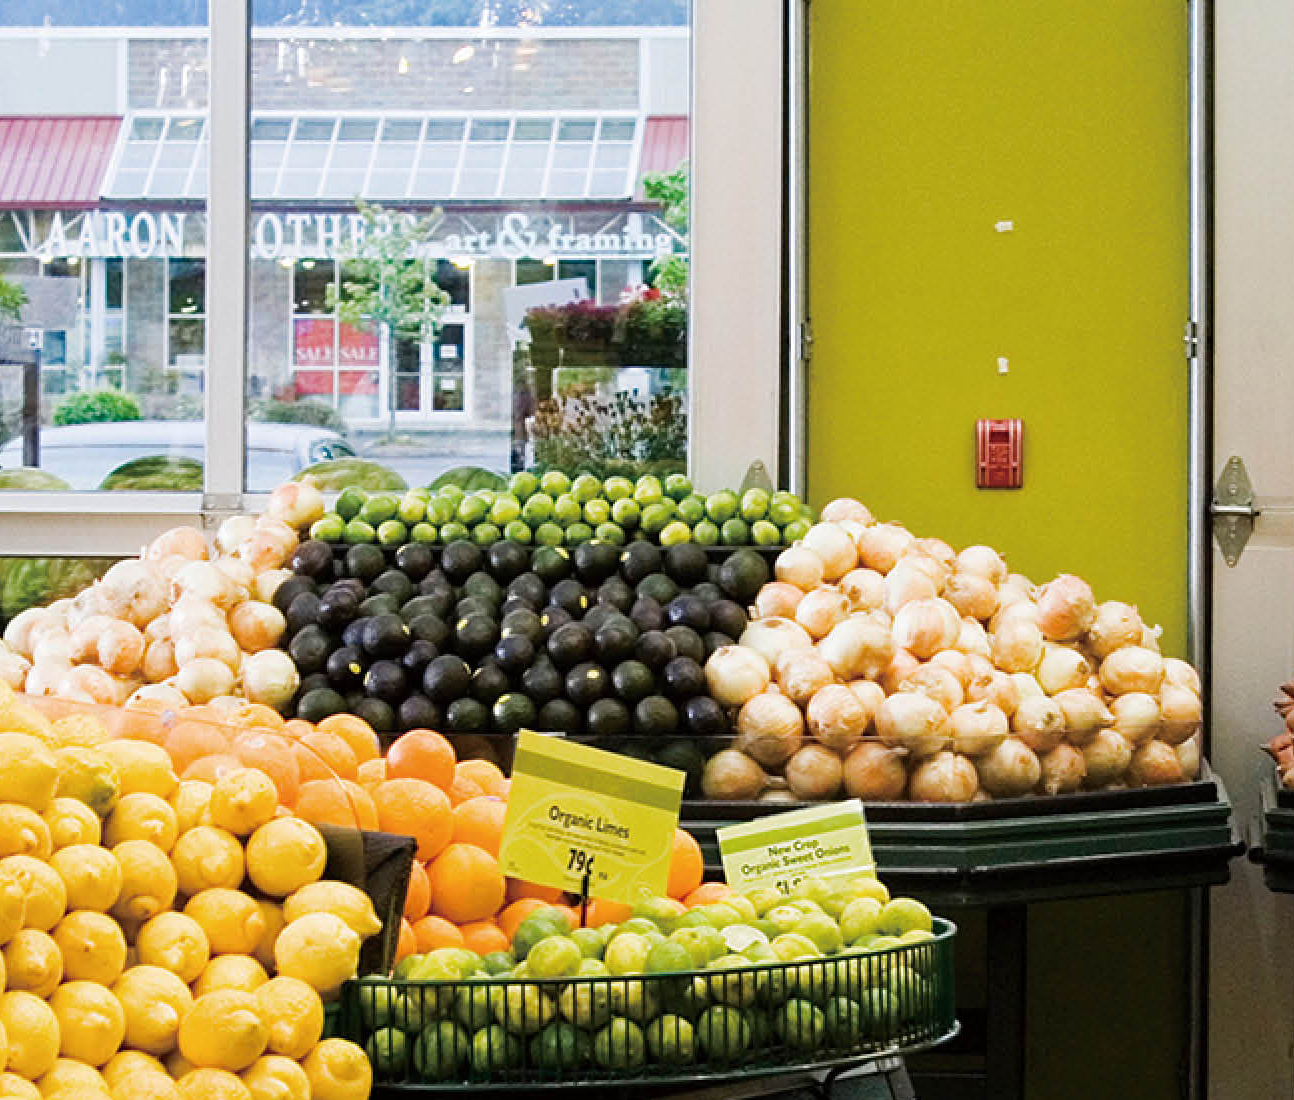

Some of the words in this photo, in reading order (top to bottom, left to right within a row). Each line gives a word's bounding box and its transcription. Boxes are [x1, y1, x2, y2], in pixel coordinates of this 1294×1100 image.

[37, 212, 189, 256] AARON
[445, 231, 491, 251] art
[502, 212, 539, 258] &
[549, 223, 671, 258] framing
[548, 805, 594, 830] Organic
[596, 816, 630, 839] Limes
[741, 860, 780, 875] Organic
[782, 851, 813, 867] Sweet
[814, 844, 851, 859] Onions
[768, 845, 792, 857] New
[793, 839, 819, 851] Crop
